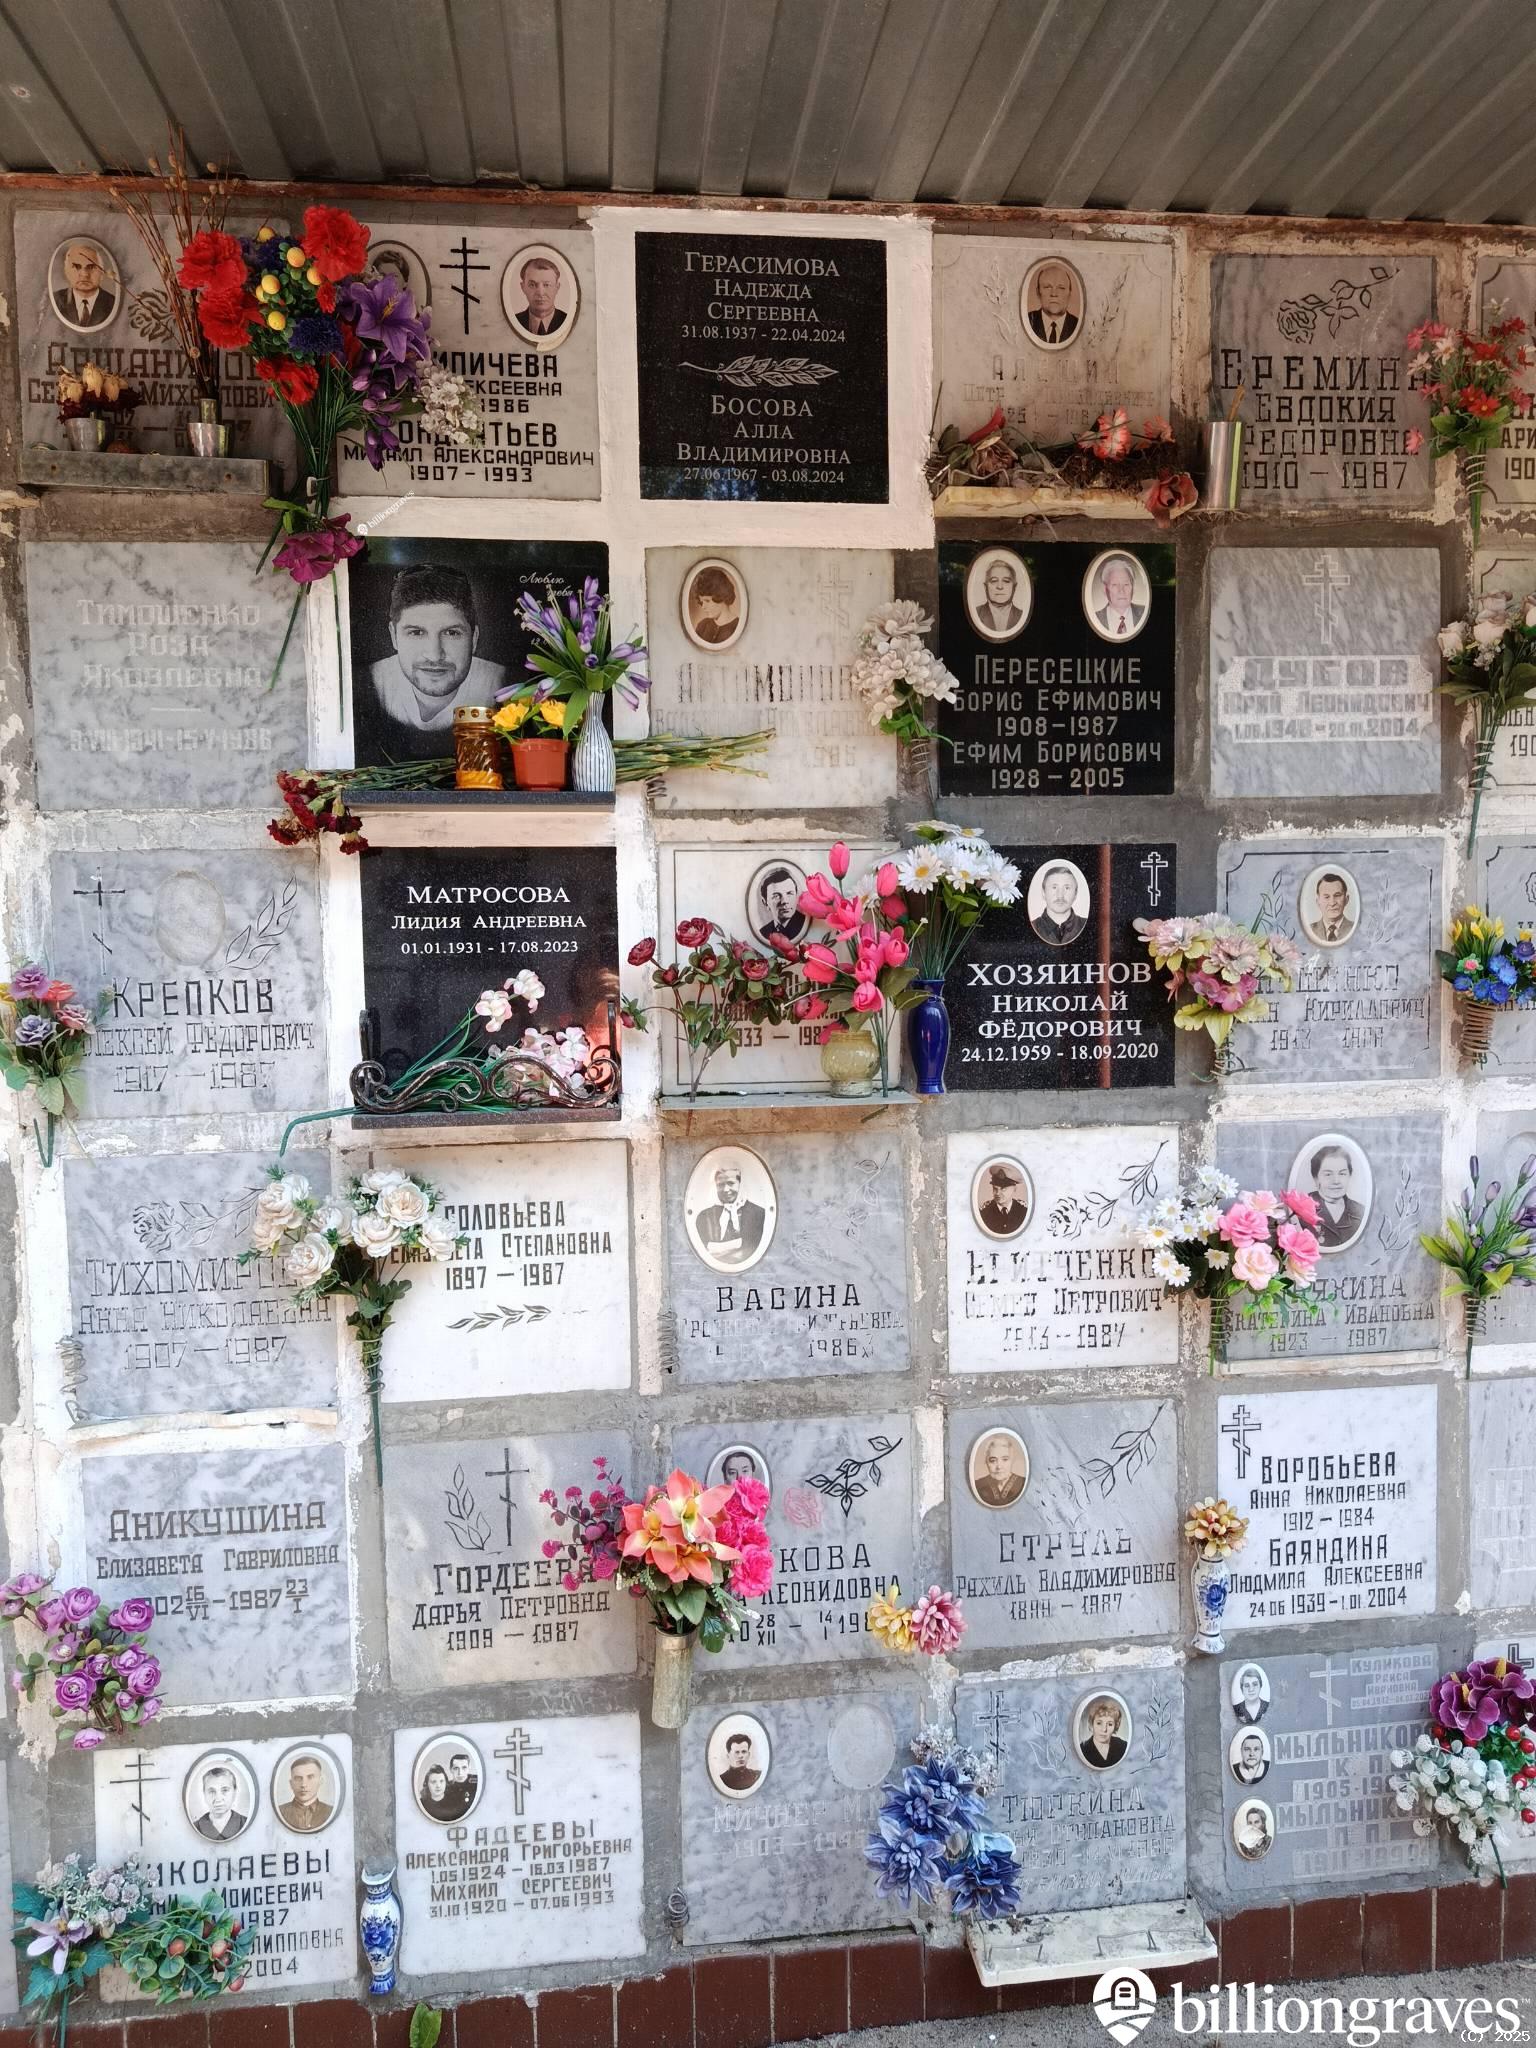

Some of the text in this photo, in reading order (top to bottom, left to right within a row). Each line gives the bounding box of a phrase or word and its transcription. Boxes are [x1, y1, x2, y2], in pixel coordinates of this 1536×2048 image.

[684, 251, 841, 277] ГЕРАСИМОВА
[714, 279, 813, 300] НАДЕЖДА
[707, 302, 820, 323] СЕРГЕЕВНА
[681, 325, 846, 343] 31.08.1937 22.04.2024
[711, 395, 814, 417] БОСОВА
[1255, 393, 1396, 425] ЕВДОКИЯ
[734, 421, 794, 439] АЛЛА
[434, 447, 594, 466] АЛЕКСАНДРОВИЧ
[677, 443, 851, 464] ВЛАДИМИРОВНА
[411, 465, 533, 483] 1907 1993
[684, 467, 845, 484] 27.06.1967 03.08.2024
[1341, 461, 1408, 490] 1987
[519, 572, 565, 585] Люблю
[128, 631, 209, 657] РОЗА
[975, 654, 1141, 685] ПЕРЕСЕЦКИЕ
[953, 689, 1161, 712] БОРИС ЕФИМОВИЧ
[953, 741, 1161, 764] ЕФИМ БОРИСОВИЧ
[991, 768, 1125, 789] 1928 2005
[407, 885, 571, 904] МАТРОСОВА
[391, 914, 587, 931] ЛИДИЯ АНДРЕЕВНА
[401, 941, 578, 955] 01.01.1931 17.08.2023
[967, 962, 1152, 986] ХОЗЯИНОВ
[113, 977, 273, 1018] КРЕПКОВ
[991, 990, 1129, 1013] НИКОЛАЙ
[799, 1026, 826, 1046] 198
[978, 1018, 1143, 1042] ФЁДОРОВИЧ
[961, 1043, 1159, 1062] 24.12.1959 18.09.2020
[113, 1061, 276, 1093] 1917 1987
[502, 1231, 612, 1258] СТЕПАНОВНА
[445, 1262, 565, 1291] 1897 1987
[716, 1283, 861, 1313] ВАСИНА
[1053, 1287, 1163, 1315] ПЕТРОВИЧ
[78, 1304, 148, 1335] АННА
[1344, 1301, 1435, 1326] ИВАНОВНА
[1076, 1322, 1126, 1349] 1987
[1269, 1327, 1387, 1353] 1923 1987
[1261, 1451, 1396, 1485] ВОРОБЬЕВА
[1250, 1482, 1406, 1510] АННА НИКОЛАЕВНА
[109, 1501, 326, 1543] АНИКУШИНА
[1283, 1507, 1375, 1531] 1912 1984
[999, 1527, 1132, 1563] СТРУЛЬ
[1269, 1534, 1387, 1567] БАЯНДИНА
[96, 1544, 340, 1580] ЕЛИЗАВЕТА ГАВРИЛОВНА
[956, 1562, 1176, 1599] РАХИЛЬ ВЛАДИМИРОВНА
[1228, 1561, 1423, 1596] ЛЮДМИЛА АЛЕКСЕЕВНА
[412, 1590, 610, 1631] ДАРЬЯ ПЕТРОВНА
[532, 1621, 579, 1645] 1987
[1351, 1655, 1432, 1673] КУЛИКОВА
[447, 1819, 594, 1848] ФАДЕЕВЫ
[405, 1838, 632, 1870] АЛЕКСАНДРА ГРИГОРЬЕВНА
[430, 1873, 612, 1901] МИХАИЛ СЕРГЕЕВИЧ
